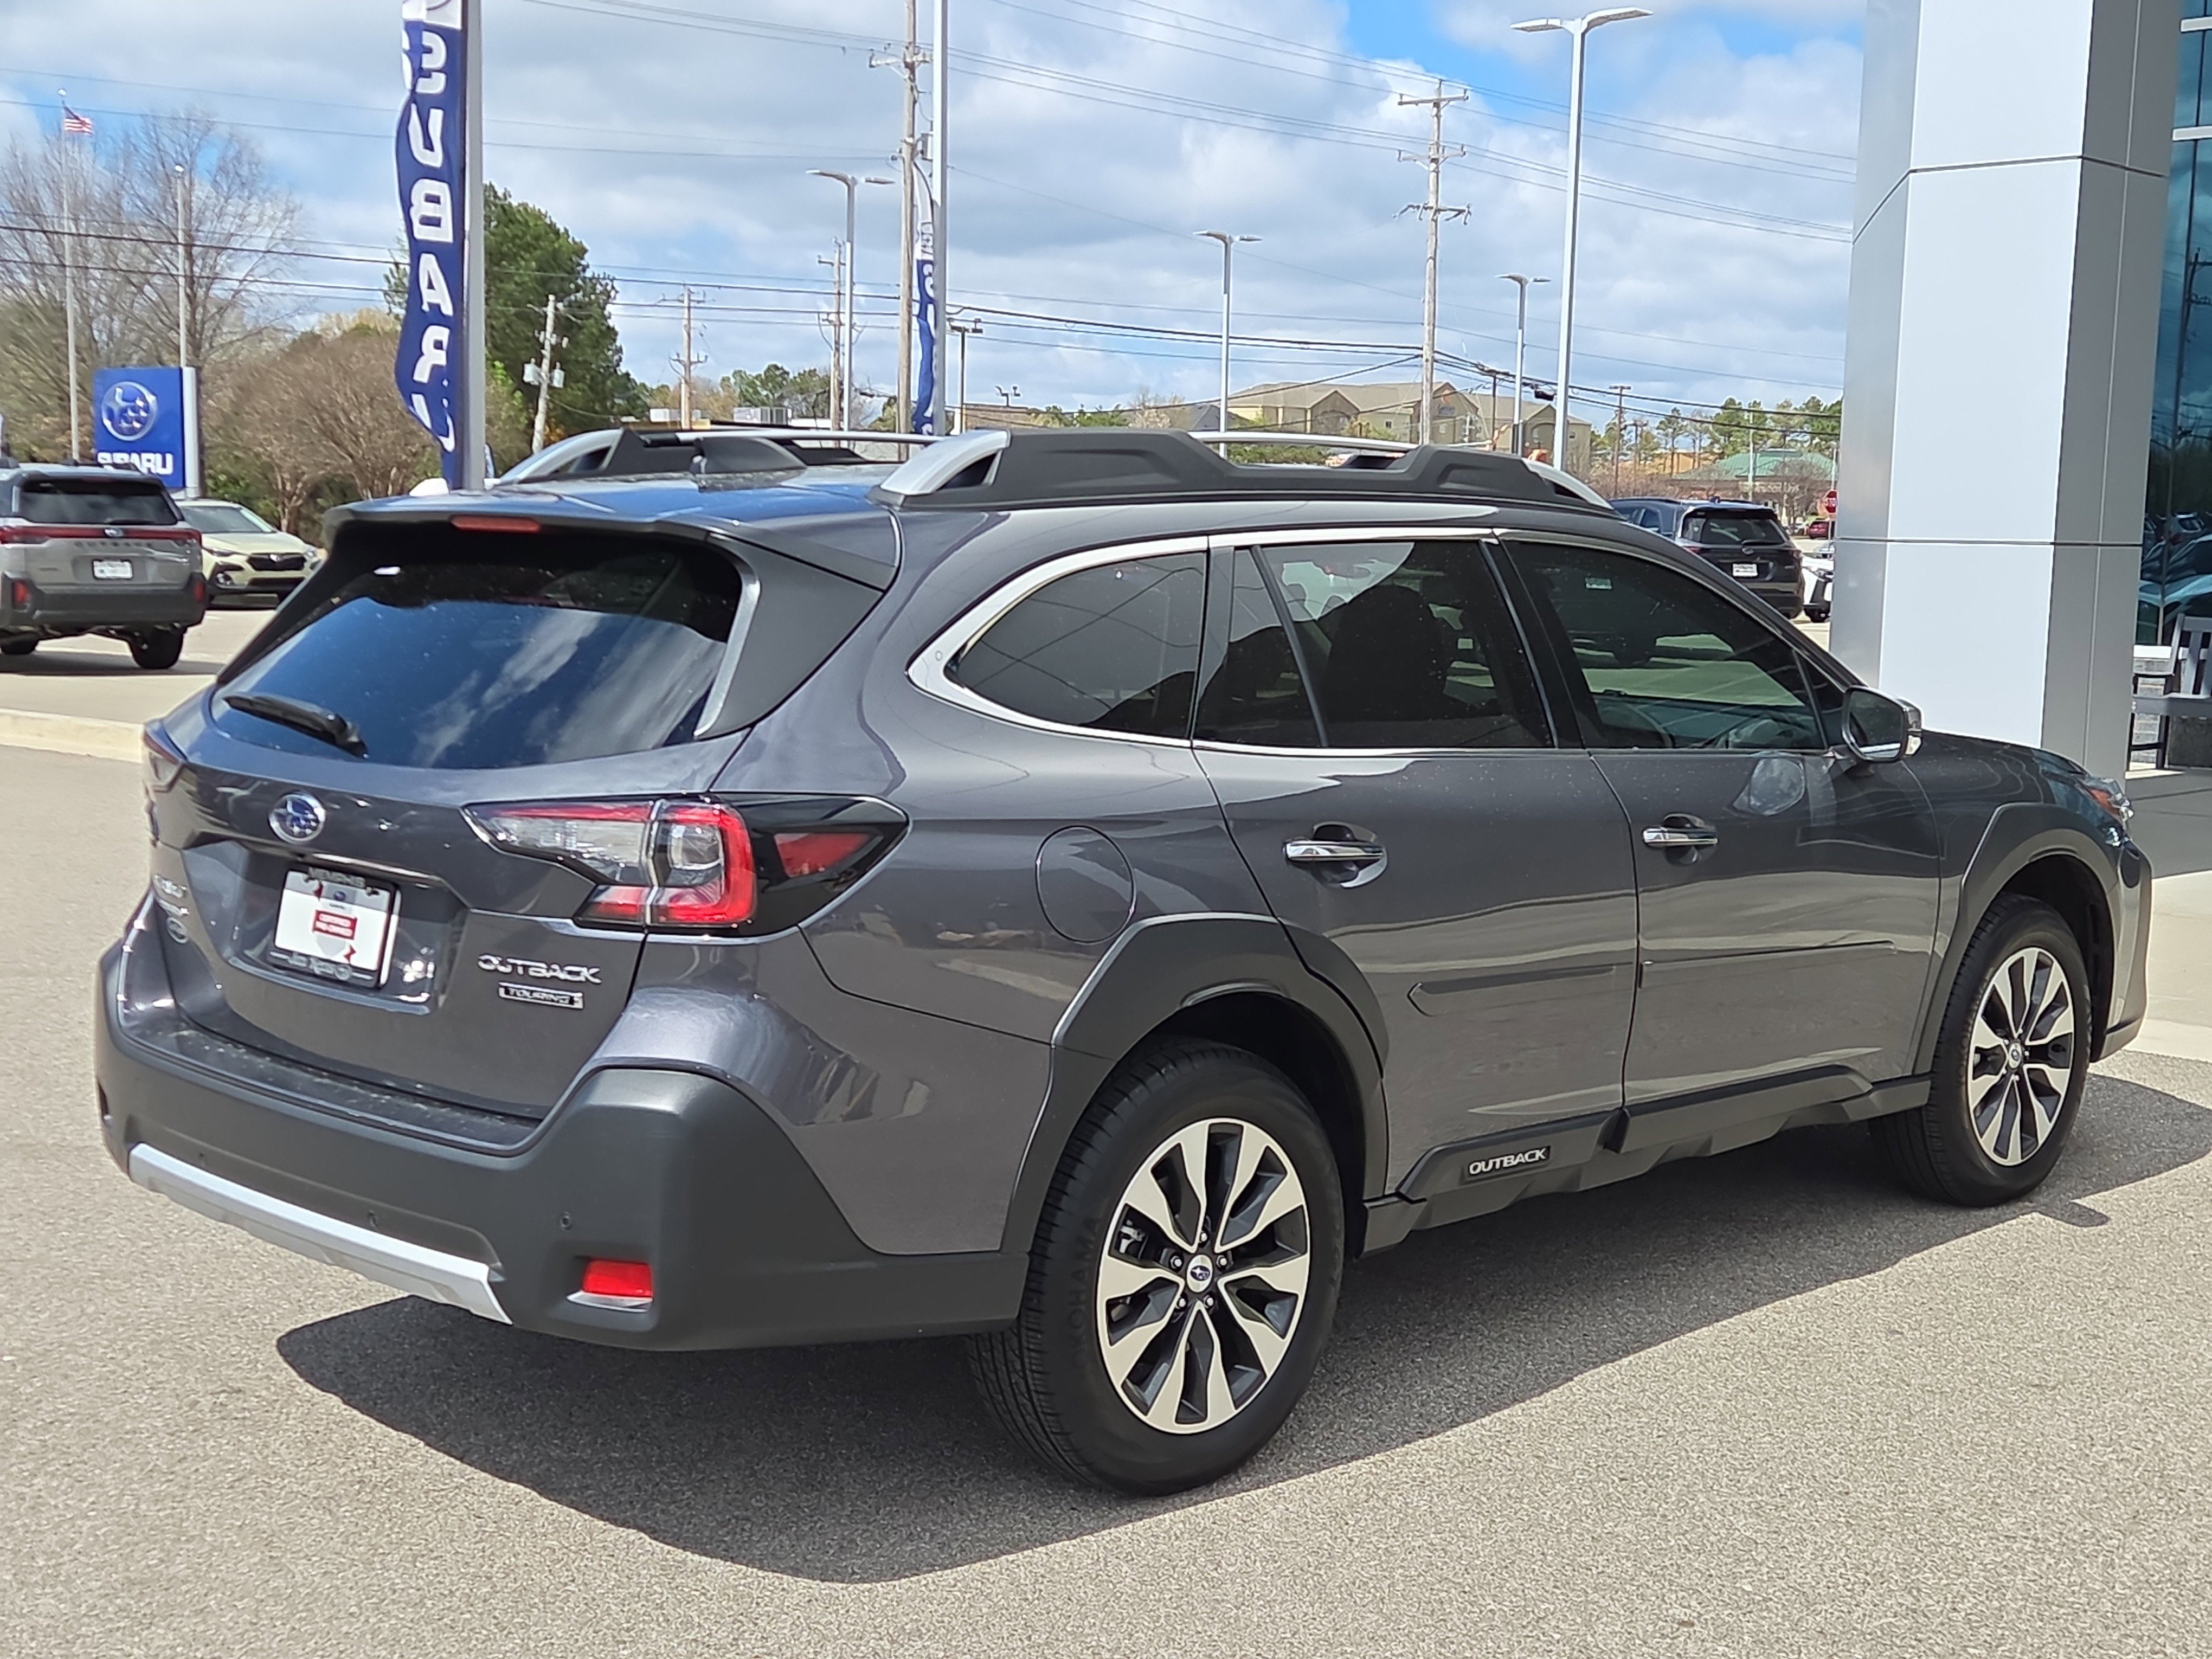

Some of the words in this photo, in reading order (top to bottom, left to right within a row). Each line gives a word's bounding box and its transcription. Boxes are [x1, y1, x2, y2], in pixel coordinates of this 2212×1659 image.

[1824, 497, 1837, 507] STO
[477, 954, 602, 984] OUTBACK
[508, 987, 570, 1004] TOURING
[1469, 1148, 1546, 1175] OUTBACK
